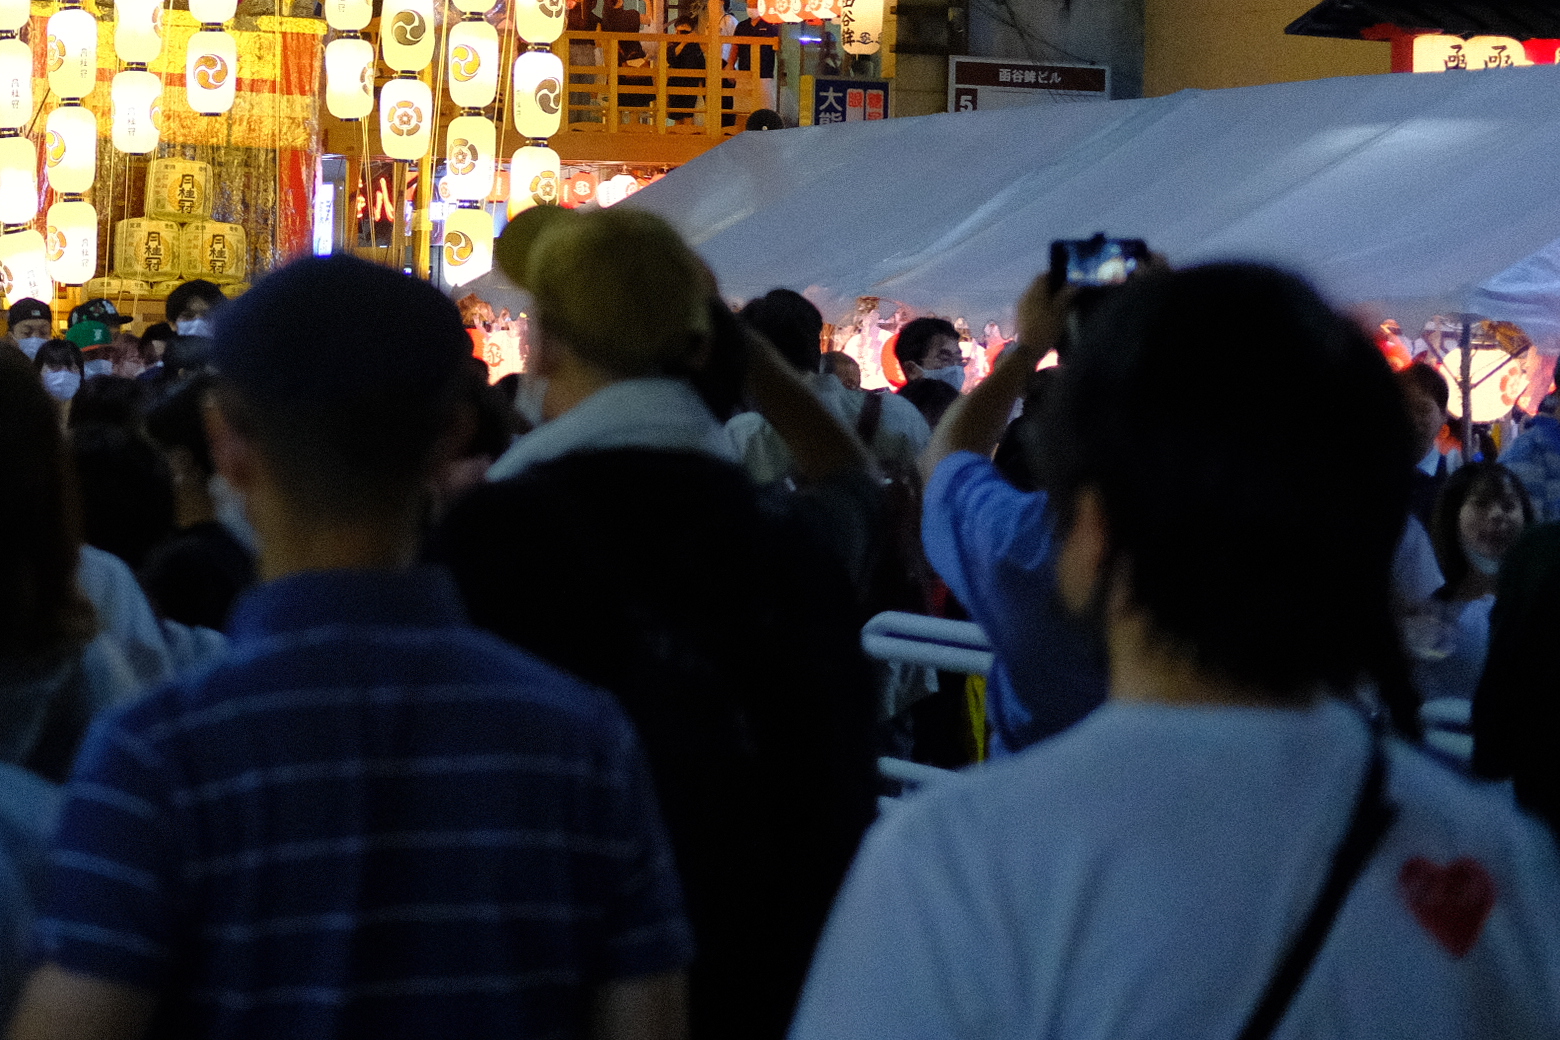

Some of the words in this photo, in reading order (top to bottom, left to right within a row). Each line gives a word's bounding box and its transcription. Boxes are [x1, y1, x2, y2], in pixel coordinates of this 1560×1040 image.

[998, 68, 1062, 85] 函谷鉾ビル
[959, 95, 974, 113] 5
[178, 173, 195, 214] 月桂冠
[144, 231, 162, 272] 月桂冠
[208, 234, 227, 274] 月桂冠
